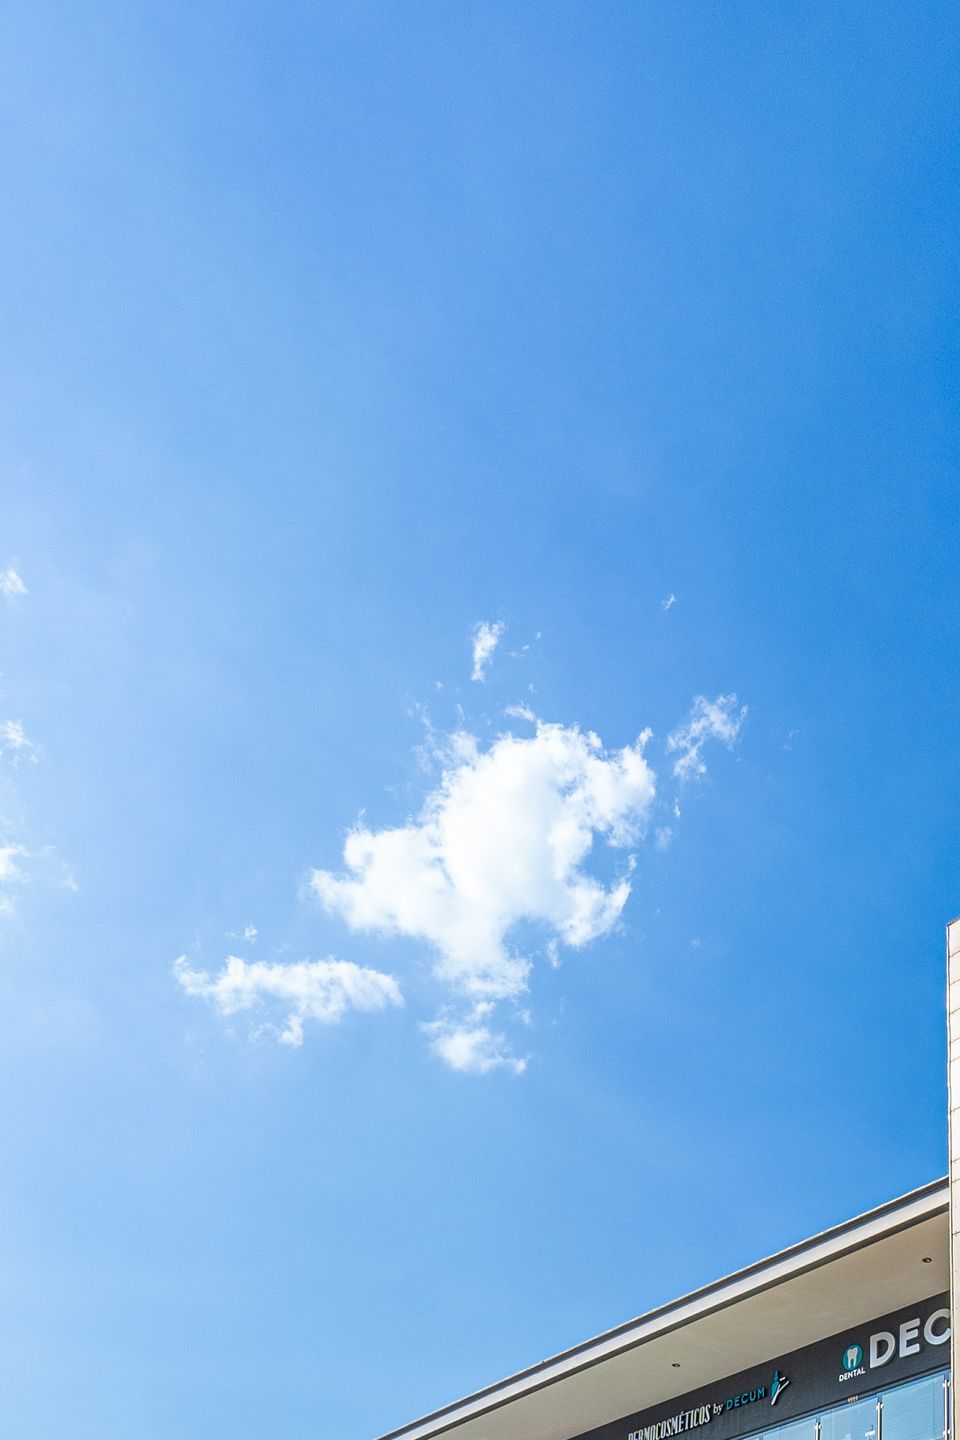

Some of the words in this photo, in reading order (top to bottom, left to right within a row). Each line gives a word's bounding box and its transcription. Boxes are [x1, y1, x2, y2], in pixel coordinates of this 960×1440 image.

[869, 1308, 951, 1369] DEC
[838, 1366, 866, 1382] DENTAL
[713, 1404, 724, 1416] by
[726, 1387, 765, 1410] DECUM
